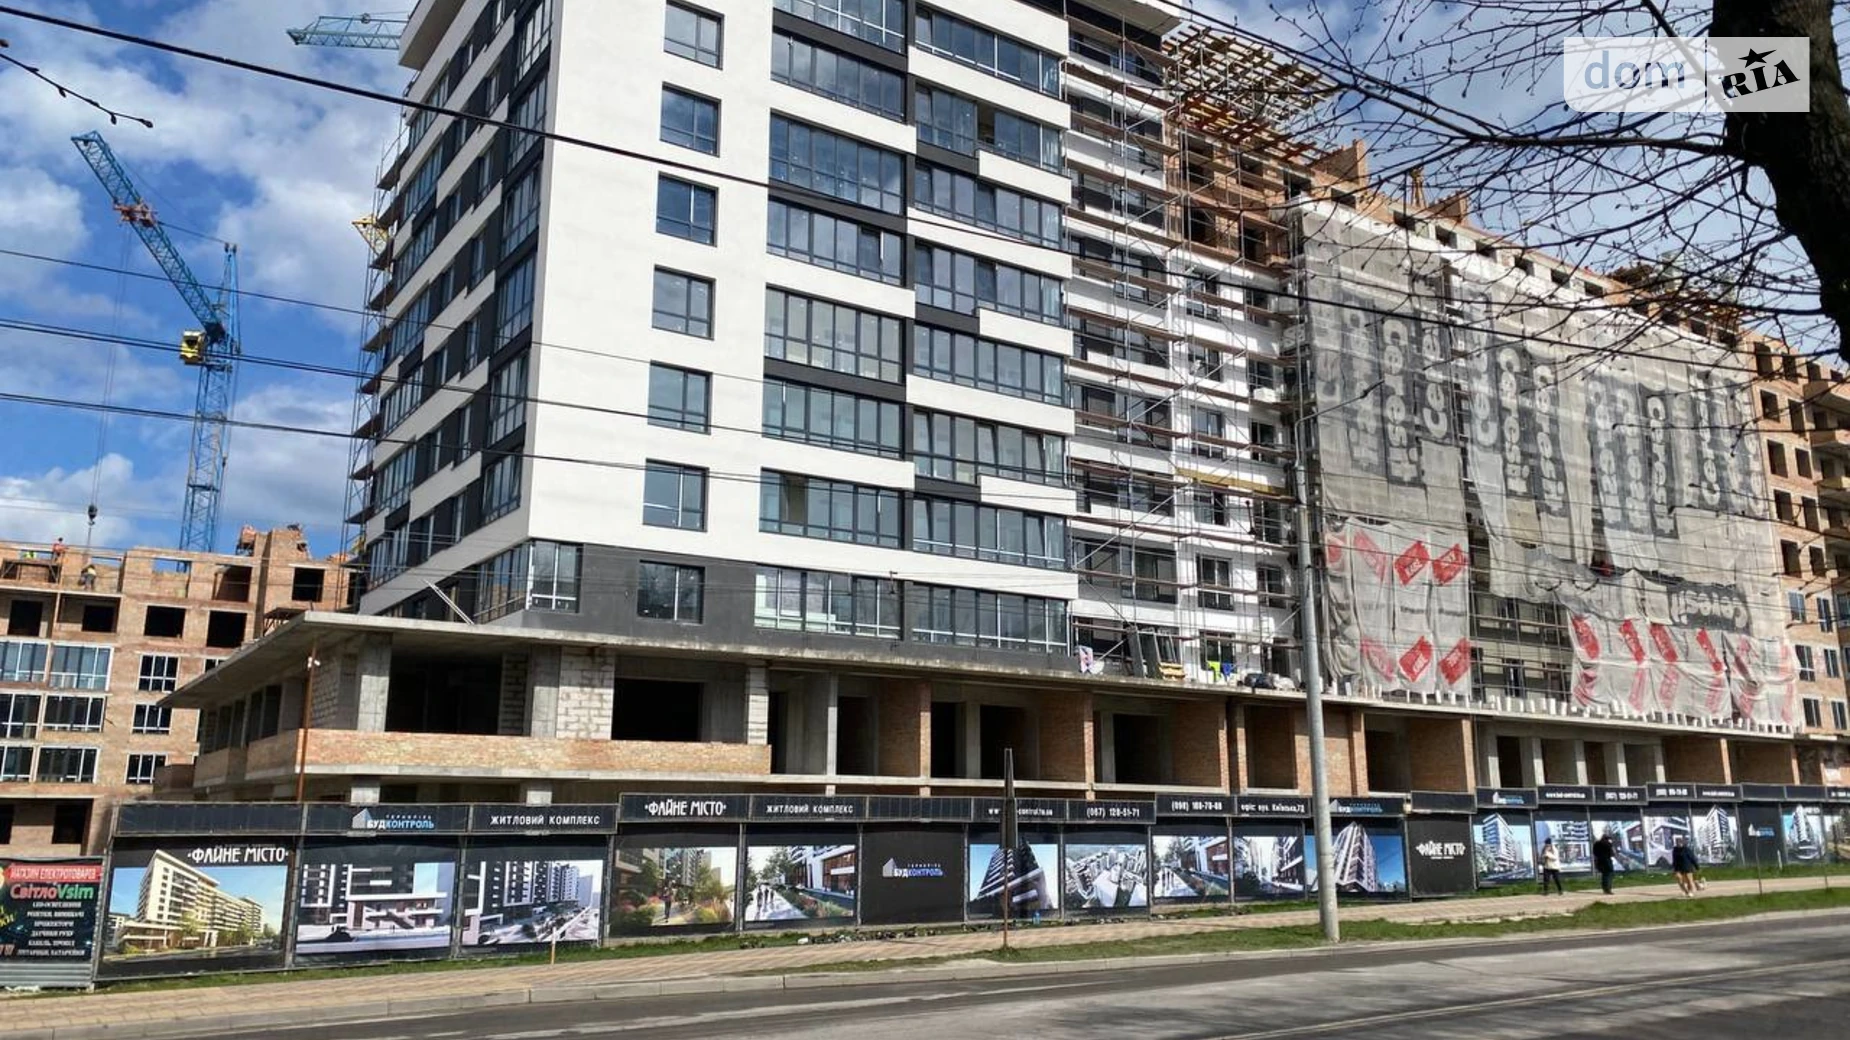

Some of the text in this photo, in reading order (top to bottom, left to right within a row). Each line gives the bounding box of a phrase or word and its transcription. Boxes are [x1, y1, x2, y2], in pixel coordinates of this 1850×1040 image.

[1383, 319, 1418, 482] Ceresit
[1499, 347, 1530, 493] Ceresit
[1533, 364, 1565, 512] Ceresit
[1647, 396, 1676, 534] Ceresit
[648, 799, 724, 816] ФАЙНЕ МІСТО
[766, 804, 854, 813] ЖИТЛОВИЙ КОМПЛЕКС
[367, 819, 435, 830] БУДКОНТРОЛЬ
[490, 815, 600, 825] ЖИТЛОВИЙ КОМПЛЕКС
[191, 845, 285, 863] ФАЙНЕ МІСТО
